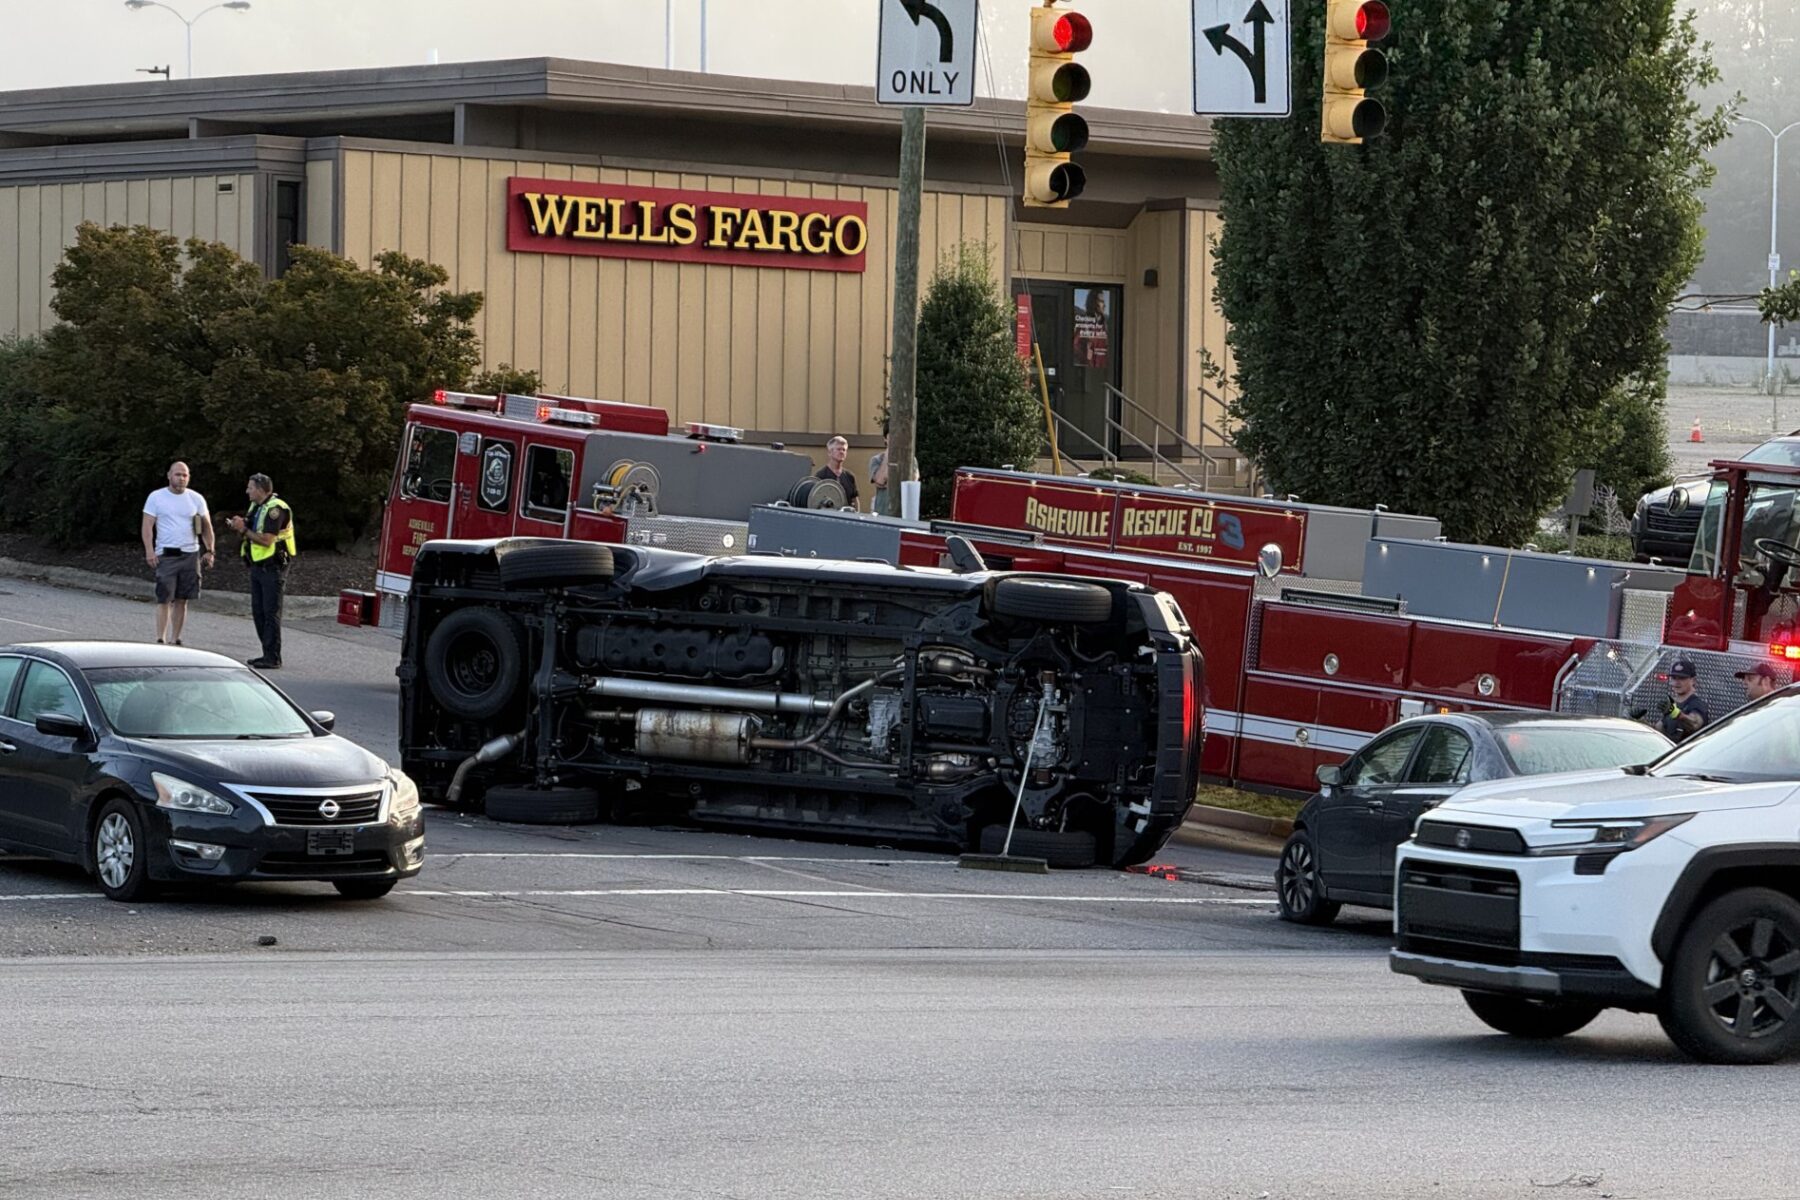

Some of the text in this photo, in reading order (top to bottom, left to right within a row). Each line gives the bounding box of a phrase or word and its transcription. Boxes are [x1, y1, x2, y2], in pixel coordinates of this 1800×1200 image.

[892, 69, 960, 95] ONLY
[523, 192, 868, 256] WELLS FARGO
[1025, 496, 1110, 537] ASHEVILLE
[1122, 508, 1188, 536] RESCUE
[1217, 512, 1245, 551] 3
[1178, 541, 1194, 552] EST.
